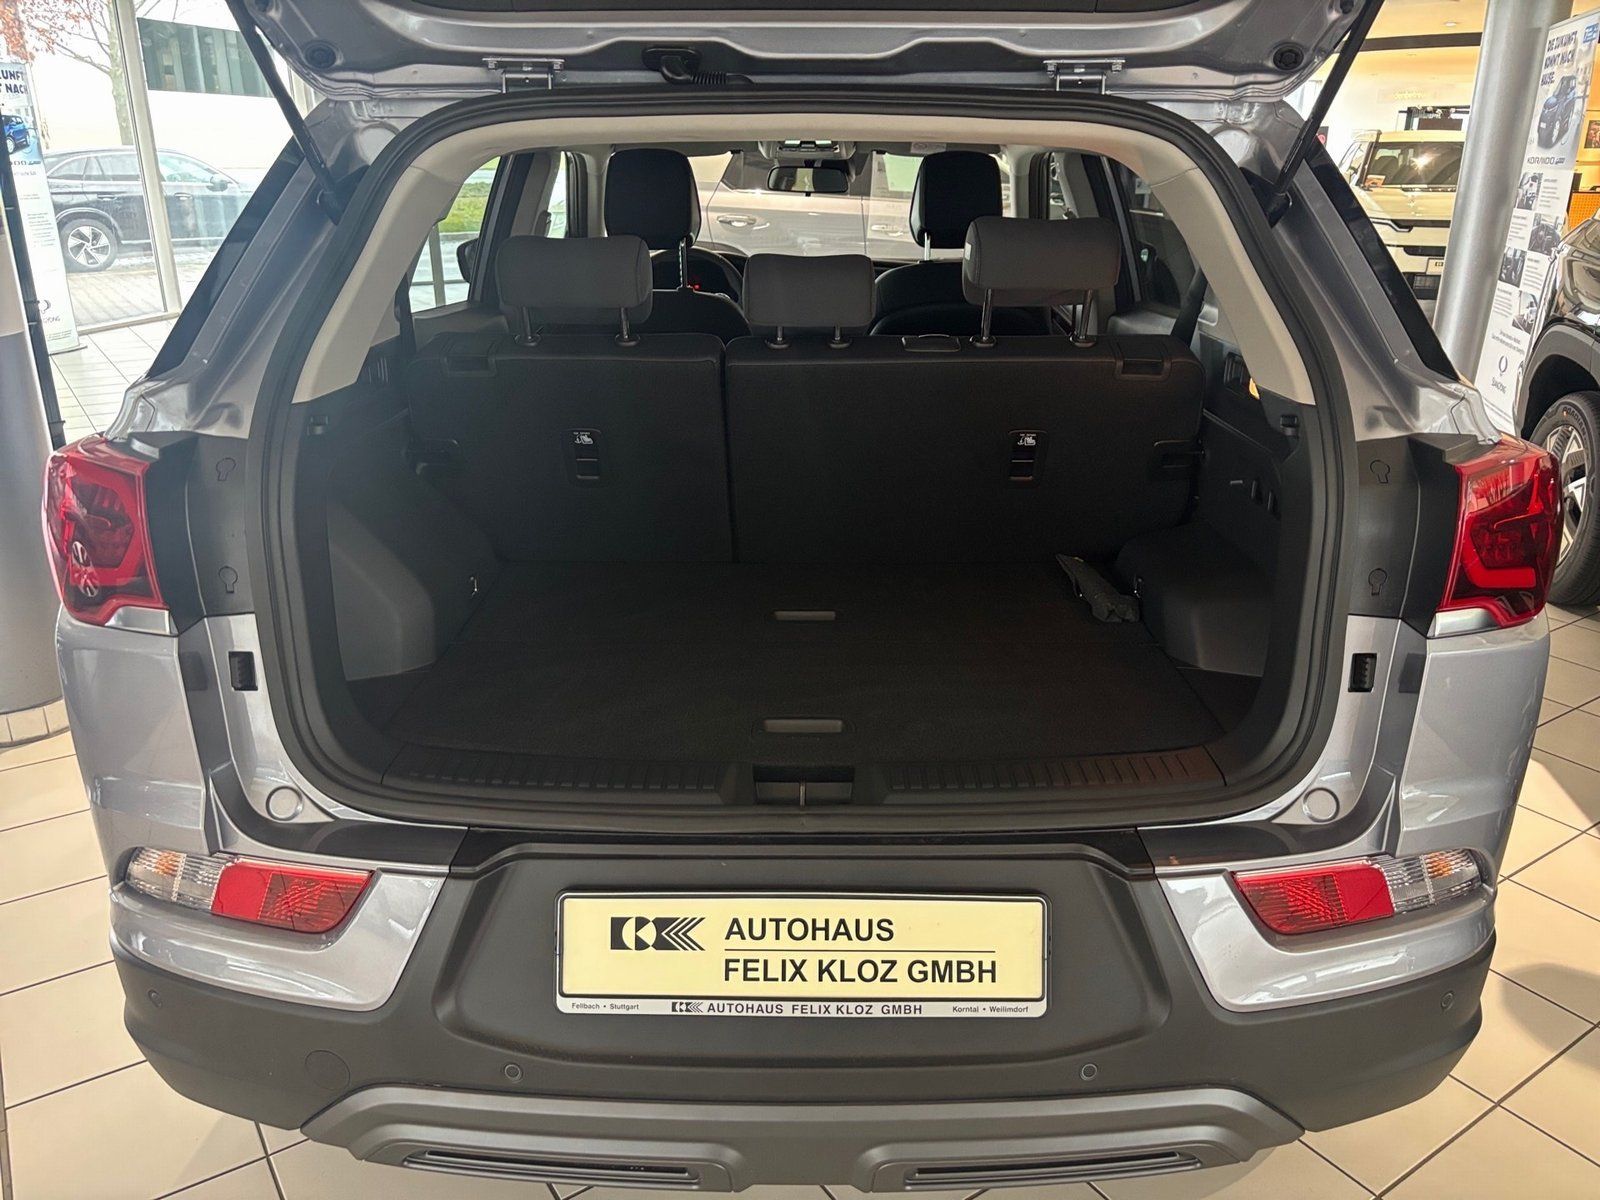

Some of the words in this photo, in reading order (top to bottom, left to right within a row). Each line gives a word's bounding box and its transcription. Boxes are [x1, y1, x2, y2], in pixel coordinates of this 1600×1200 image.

[0, 69, 25, 81] UNFT
[724, 917, 895, 942] AUTOHAUS
[724, 958, 808, 983] FELIX
[818, 959, 898, 983] KLOZ
[907, 959, 997, 984] GMBH
[571, 1002, 600, 1010] Fellbach
[609, 1003, 640, 1011] Stuttgart
[707, 1003, 784, 1014] AUTOHAUS
[791, 1004, 832, 1015] FELIX
[836, 1005, 873, 1015] KLOZ
[881, 1005, 923, 1015] GMBH
[952, 1005, 980, 1014] Korntal
[989, 1006, 1029, 1014] Weilimdorf
